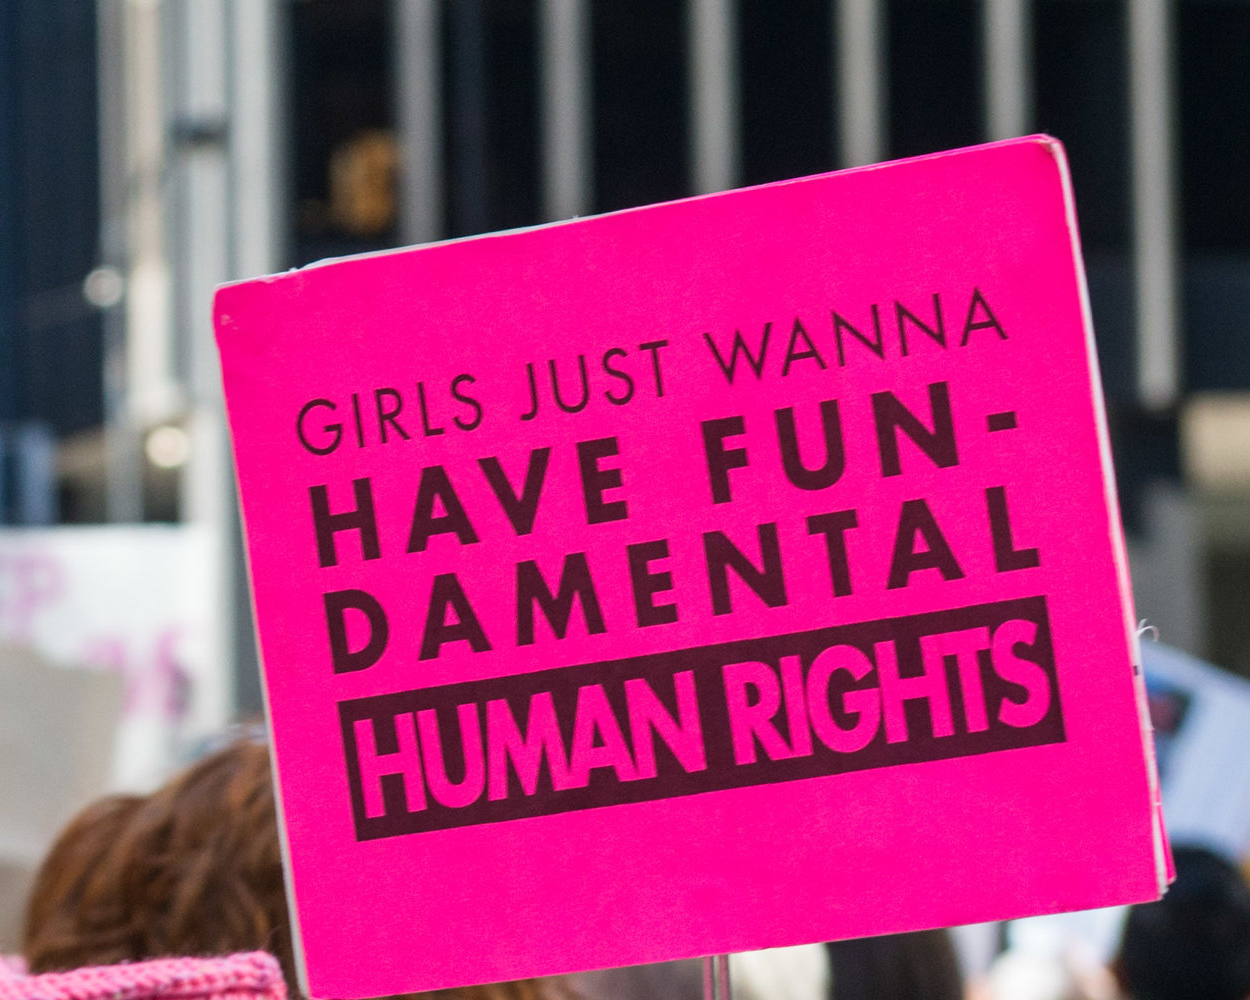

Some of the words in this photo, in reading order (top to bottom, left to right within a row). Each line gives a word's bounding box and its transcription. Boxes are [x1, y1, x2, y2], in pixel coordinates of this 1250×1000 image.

[297, 374, 482, 455] GIRLS
[521, 339, 669, 420] JUST
[704, 288, 1007, 384] WANNA
[309, 437, 628, 568] HAVE
[701, 382, 1017, 504] FUN-
[323, 486, 1040, 674] DAMENTAL
[354, 670, 707, 818] HUMAN
[723, 619, 1050, 766] RIGHTS
